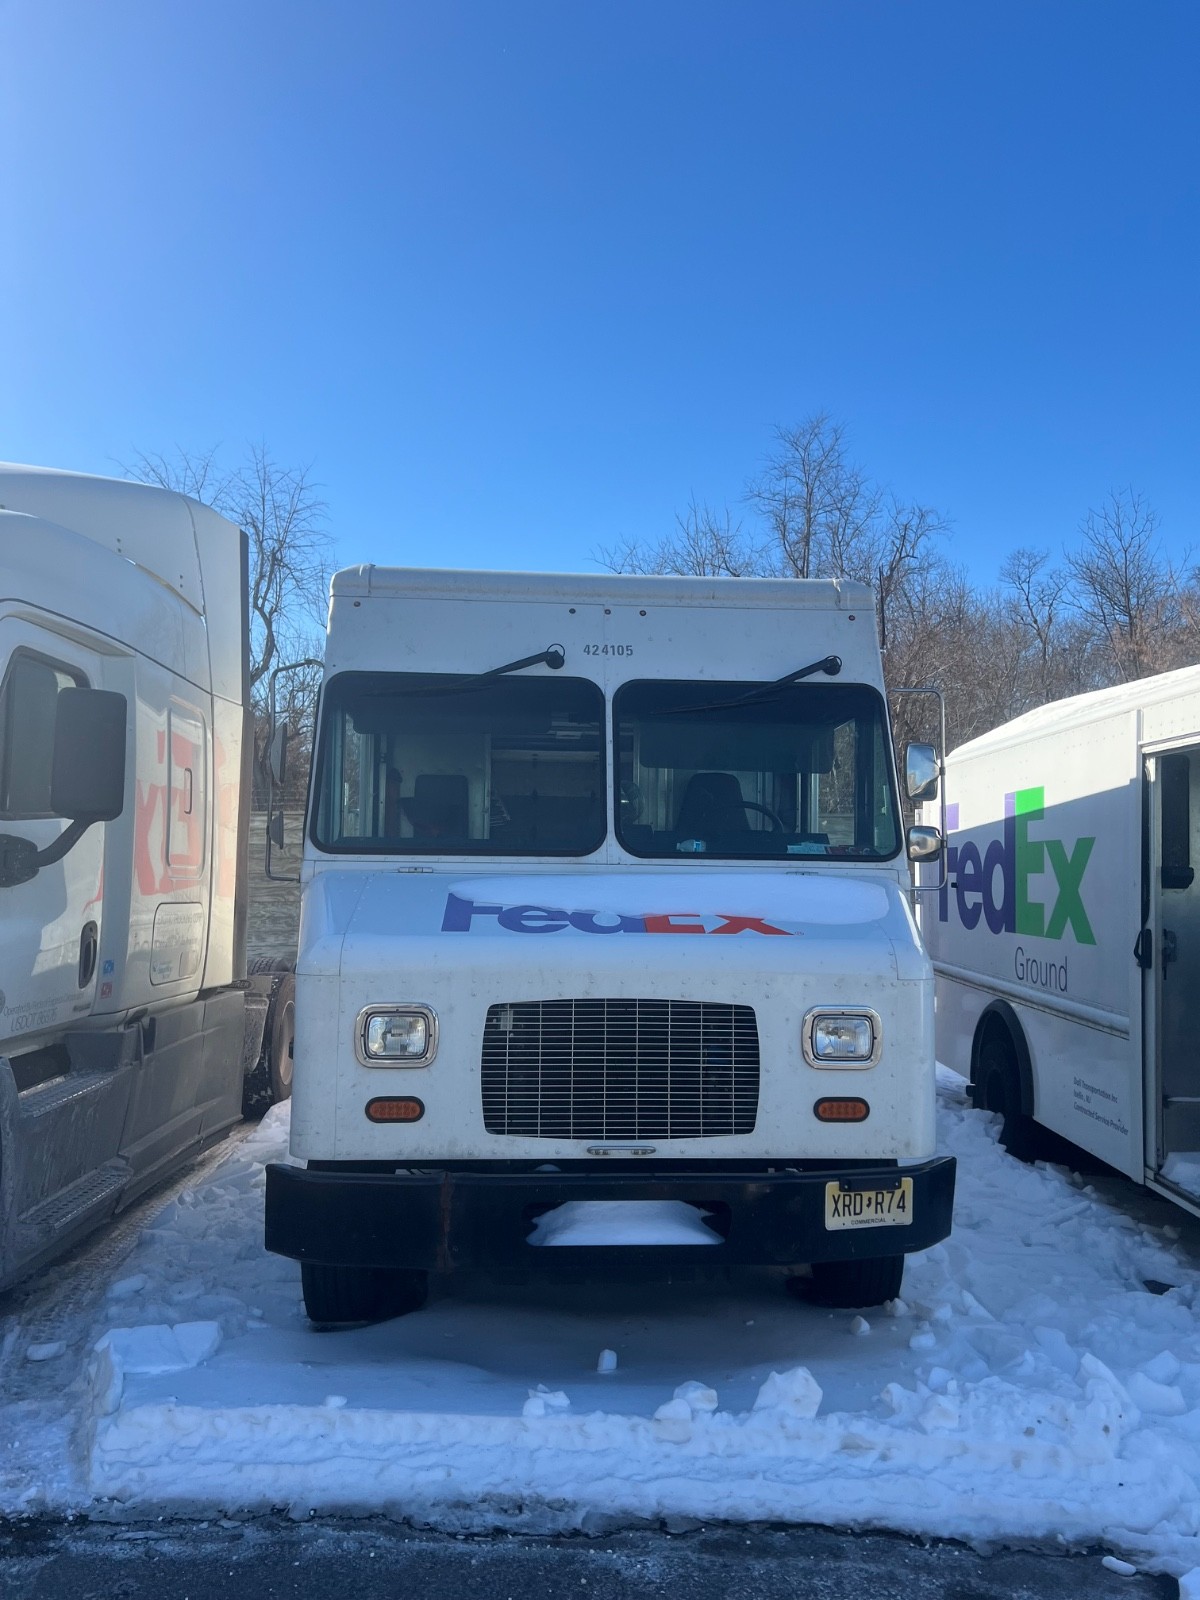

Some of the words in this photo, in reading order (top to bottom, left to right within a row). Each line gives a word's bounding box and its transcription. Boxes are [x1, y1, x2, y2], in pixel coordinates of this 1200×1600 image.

[583, 644, 634, 656] 424105
[938, 785, 1097, 946] FedEx
[1014, 946, 1068, 993] Ground
[850, 1217, 887, 1226] COMMERCIAL
